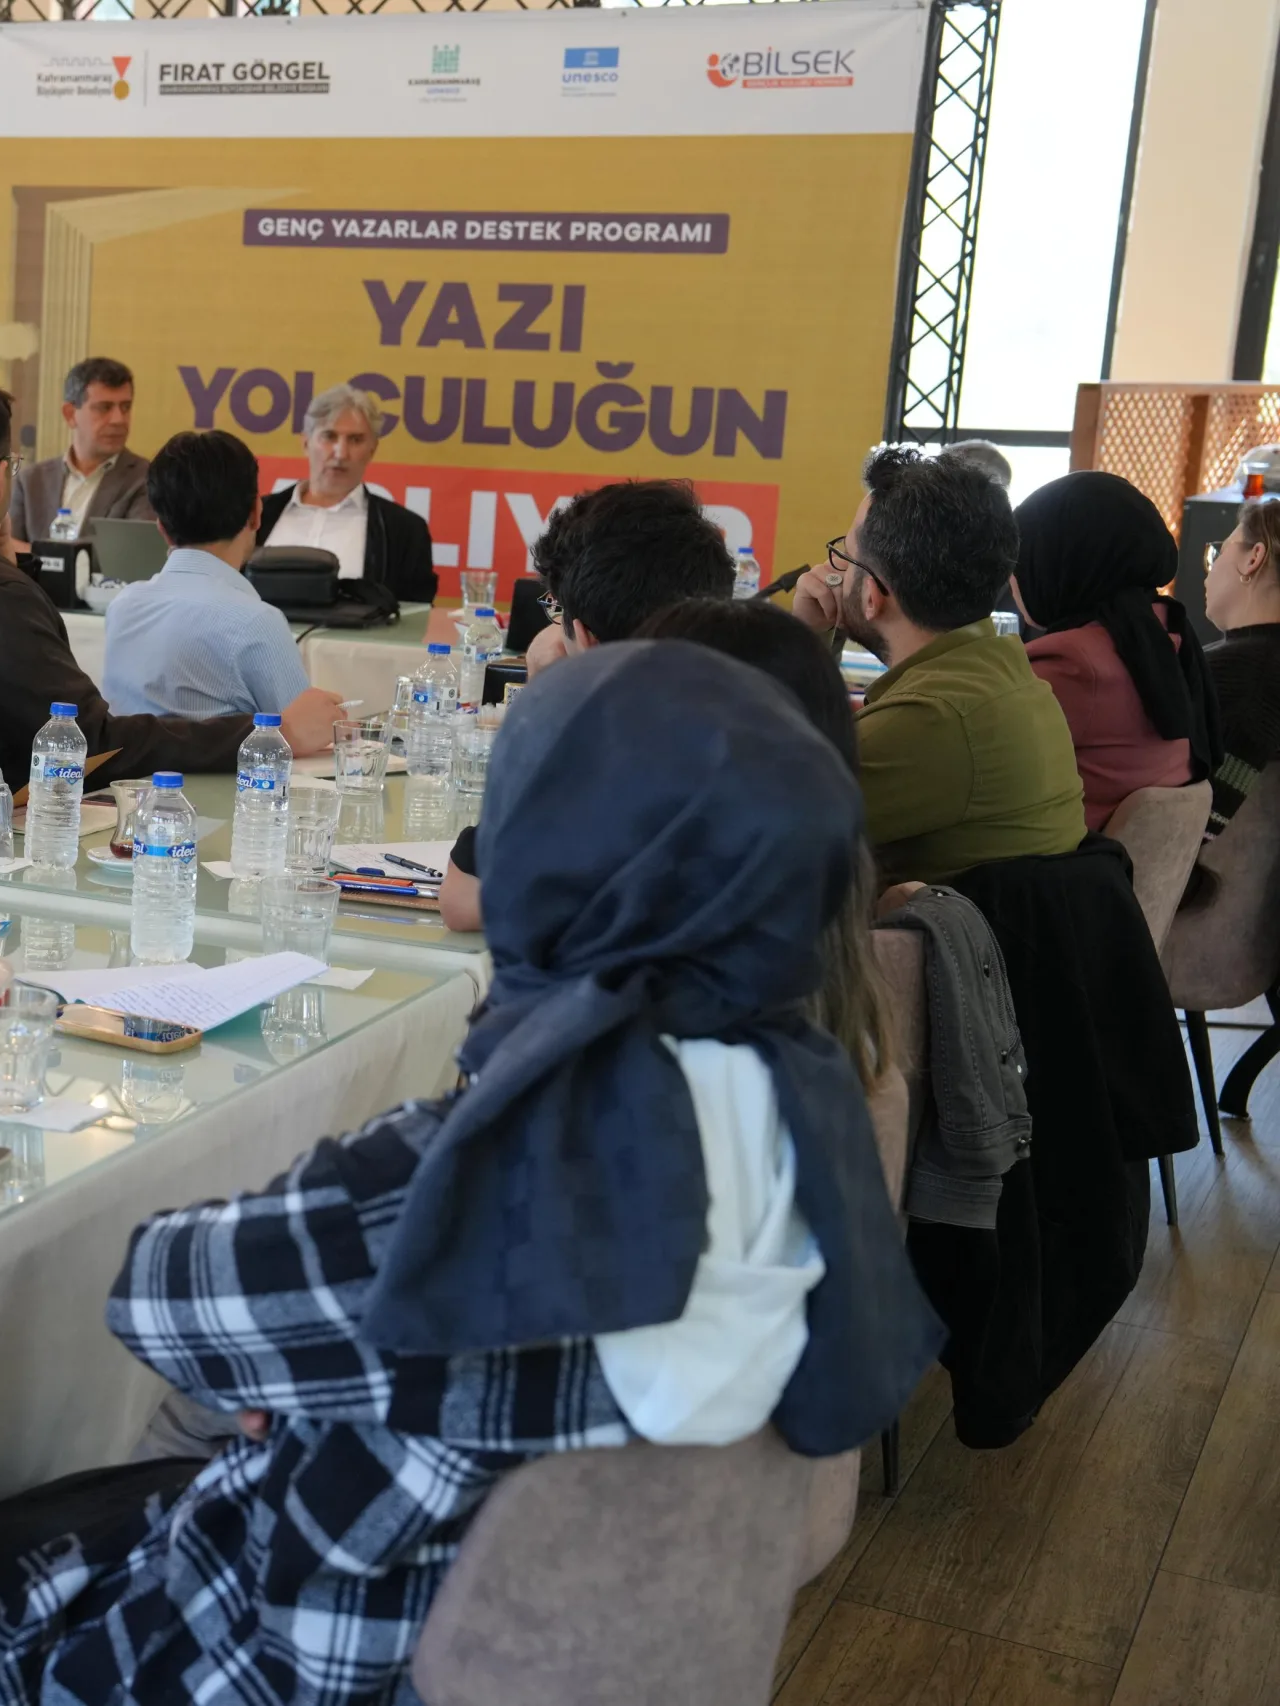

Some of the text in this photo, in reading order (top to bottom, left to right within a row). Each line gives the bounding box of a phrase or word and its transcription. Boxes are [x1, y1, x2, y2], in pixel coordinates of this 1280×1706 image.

[159, 59, 331, 82] FIRAT GÖRGEL
[743, 46, 855, 76] BİLSEK
[561, 72, 619, 83] unesco
[257, 217, 712, 243] GENÇ YAZARLAR DESTEK PROGRAMI
[362, 279, 587, 353] YAZI
[59, 767, 84, 779] ideal
